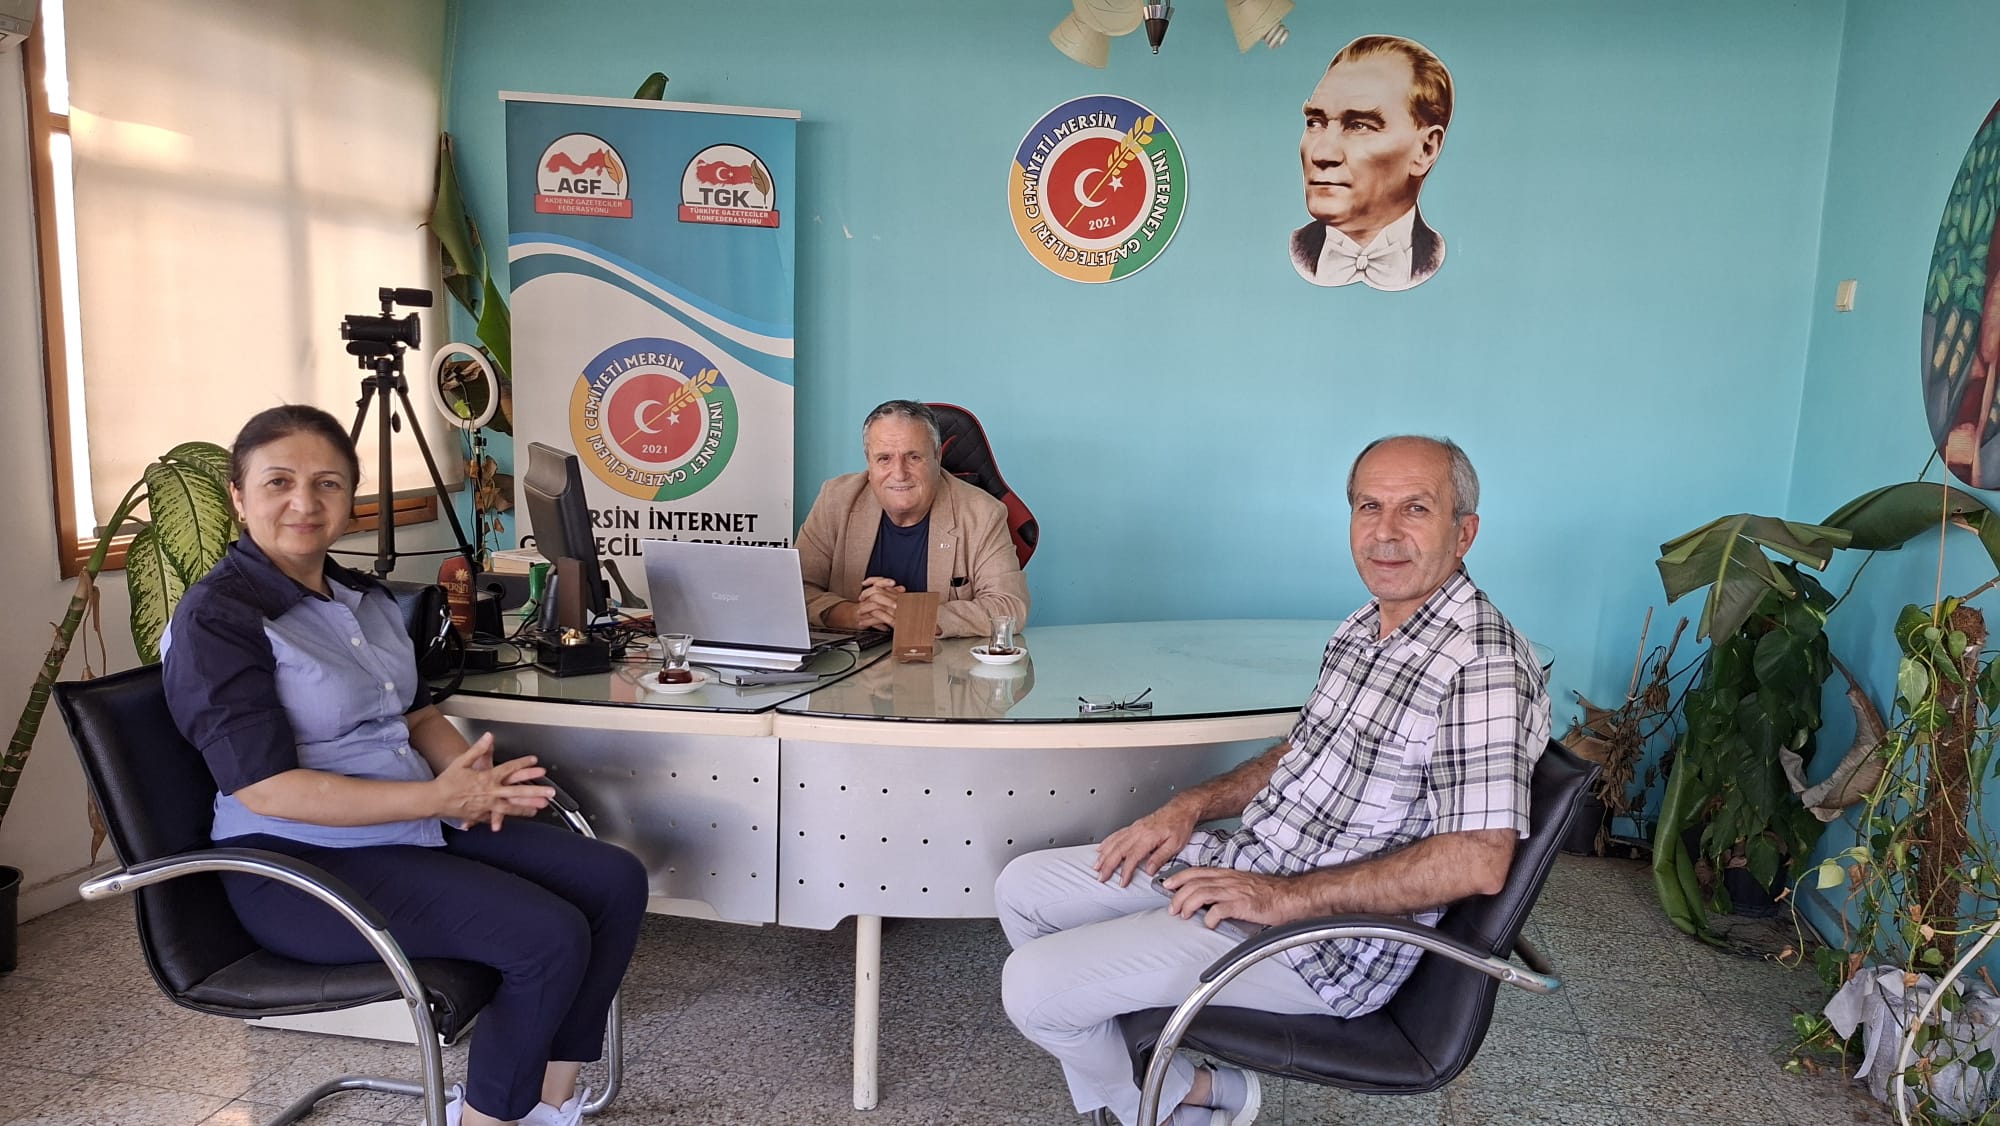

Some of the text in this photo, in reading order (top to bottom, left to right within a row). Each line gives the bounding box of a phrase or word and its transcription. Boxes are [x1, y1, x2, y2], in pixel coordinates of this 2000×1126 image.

[557, 177, 602, 195] AGF
[1022, 110, 1171, 267] MERSİN İNTERNET GAZETECİLERİ CEMİYETİ
[698, 187, 750, 209] TGK
[690, 207, 769, 218] TÜRKİYE GAZETECİLER
[696, 214, 762, 225] KONFEDERASYONU
[1088, 215, 1117, 230] 2021
[623, 352, 684, 372] MERSİN
[584, 359, 624, 431] CEMİYETİ
[692, 400, 724, 476] İNTERNET
[642, 444, 668, 454] 2021
[648, 506, 758, 533] İNTERNET
